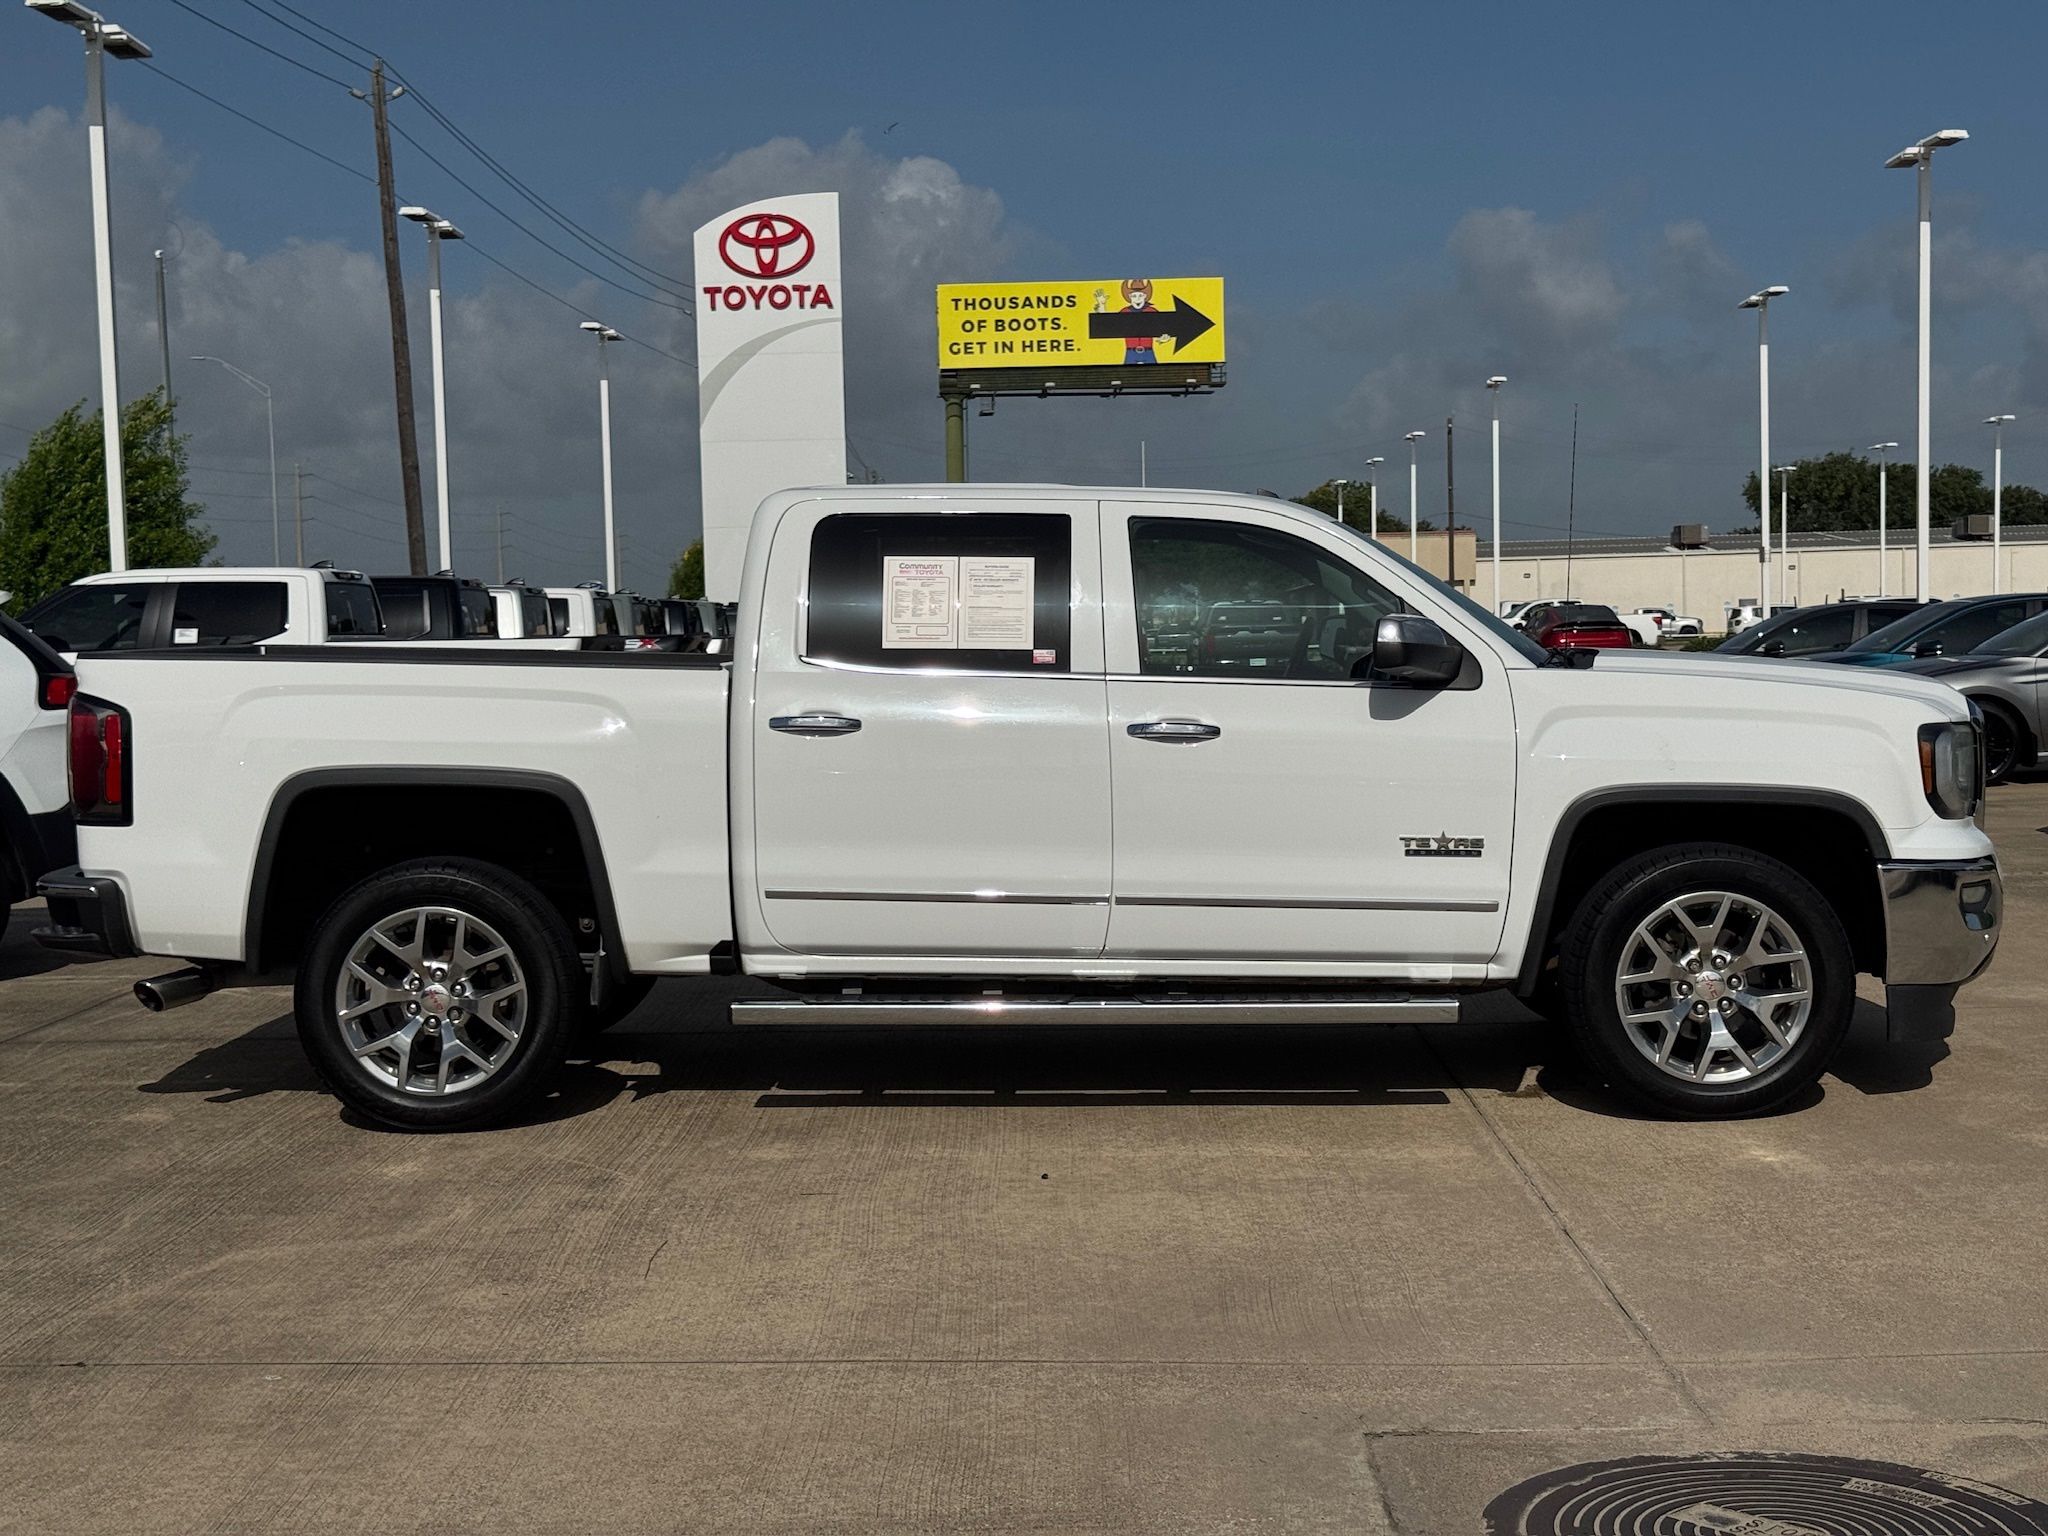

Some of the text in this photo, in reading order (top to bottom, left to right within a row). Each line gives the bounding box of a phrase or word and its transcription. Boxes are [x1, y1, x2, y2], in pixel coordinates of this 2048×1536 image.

[703, 284, 834, 312] TOYOTA
[951, 295, 1077, 311] THOUSANDS
[961, 317, 1067, 333] OF BOOTS.
[949, 339, 1081, 355] GET IN HERE.
